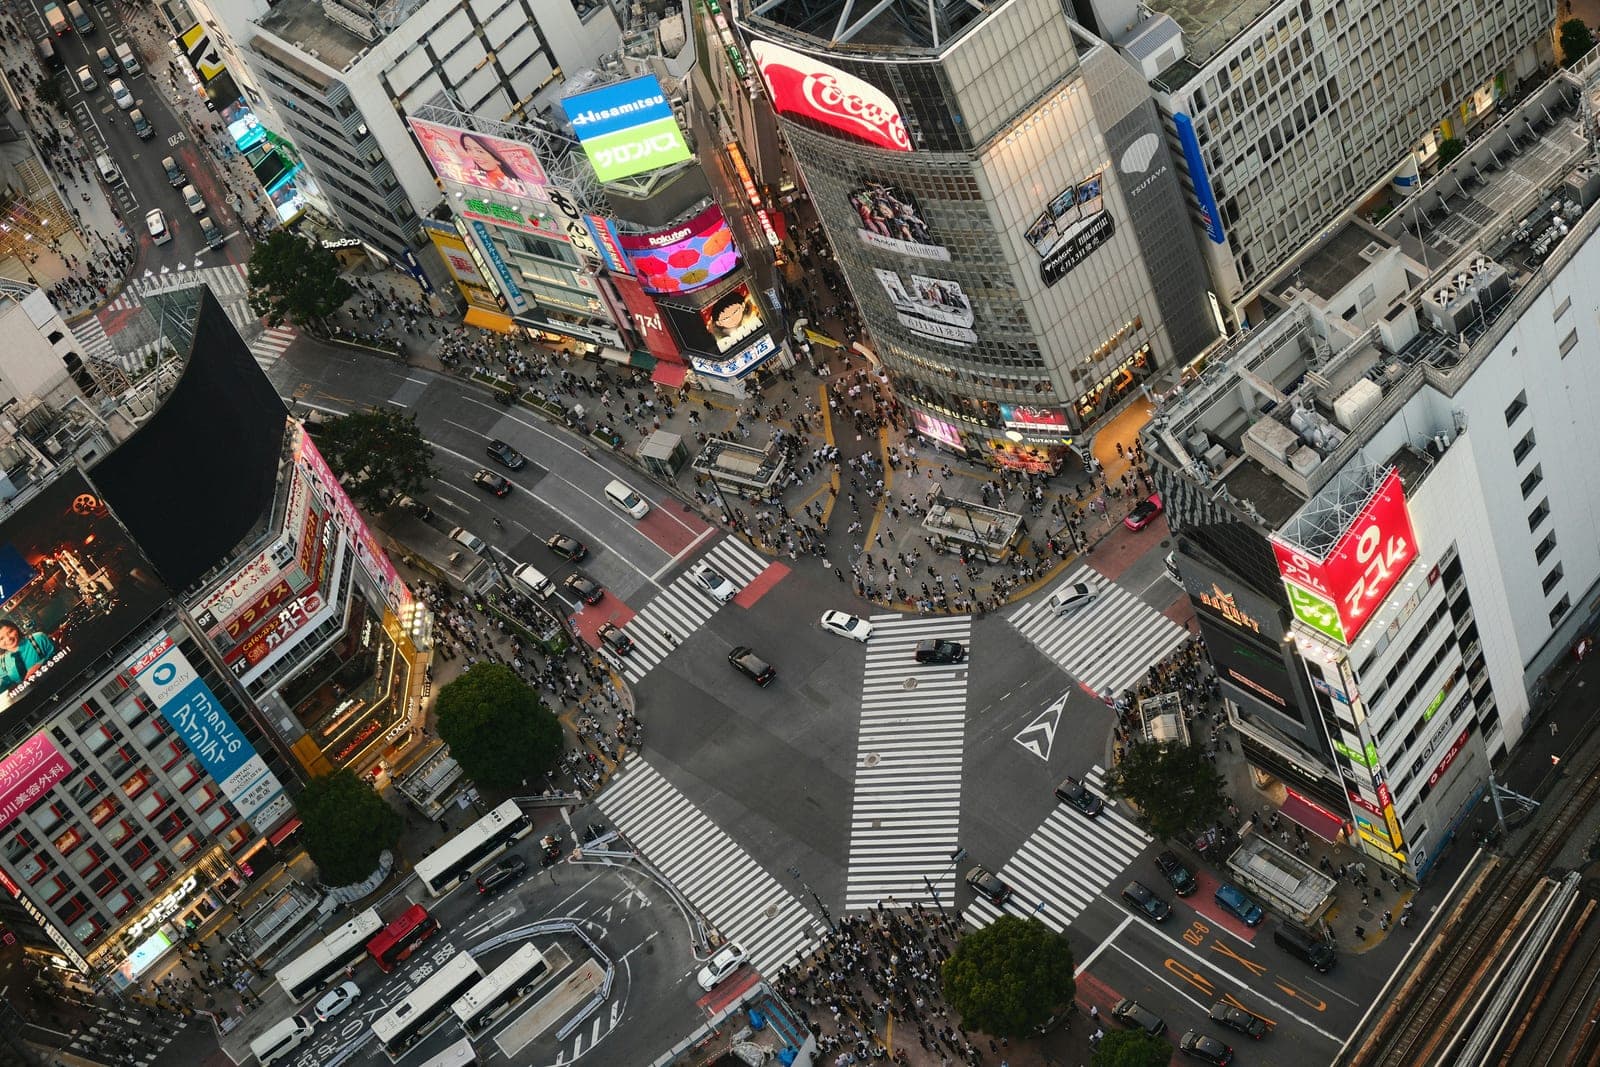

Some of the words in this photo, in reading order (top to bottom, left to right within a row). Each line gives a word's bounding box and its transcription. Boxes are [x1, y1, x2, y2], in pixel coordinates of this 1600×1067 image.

[572, 94, 664, 125] Hisamitsu
[167, 131, 186, 147] 8-20
[594, 132, 680, 168] サロンパス
[1131, 165, 1167, 197] TSUTAYA
[648, 227, 691, 246] Rakuten
[1051, 246, 1074, 267] MAGIC
[696, 342, 769, 373] 大盛堂書店
[911, 394, 988, 426] STARBUCKS
[232, 566, 271, 600] しゃぶ葉
[1283, 560, 1326, 592] アコム
[1345, 535, 1407, 617] アコム
[198, 613, 213, 628] 9F
[278, 594, 309, 624] ガスト
[266, 608, 302, 648] ガスト
[231, 658, 248, 675] 7F
[157, 671, 190, 702] eyecity
[172, 703, 228, 765] アイシティ
[191, 692, 242, 755] コンタクトの
[2, 749, 43, 787] クリニック
[1440, 745, 1459, 773] アコム
[128, 877, 198, 938] サンドラッグ
[1183, 921, 1210, 946] 8-20
